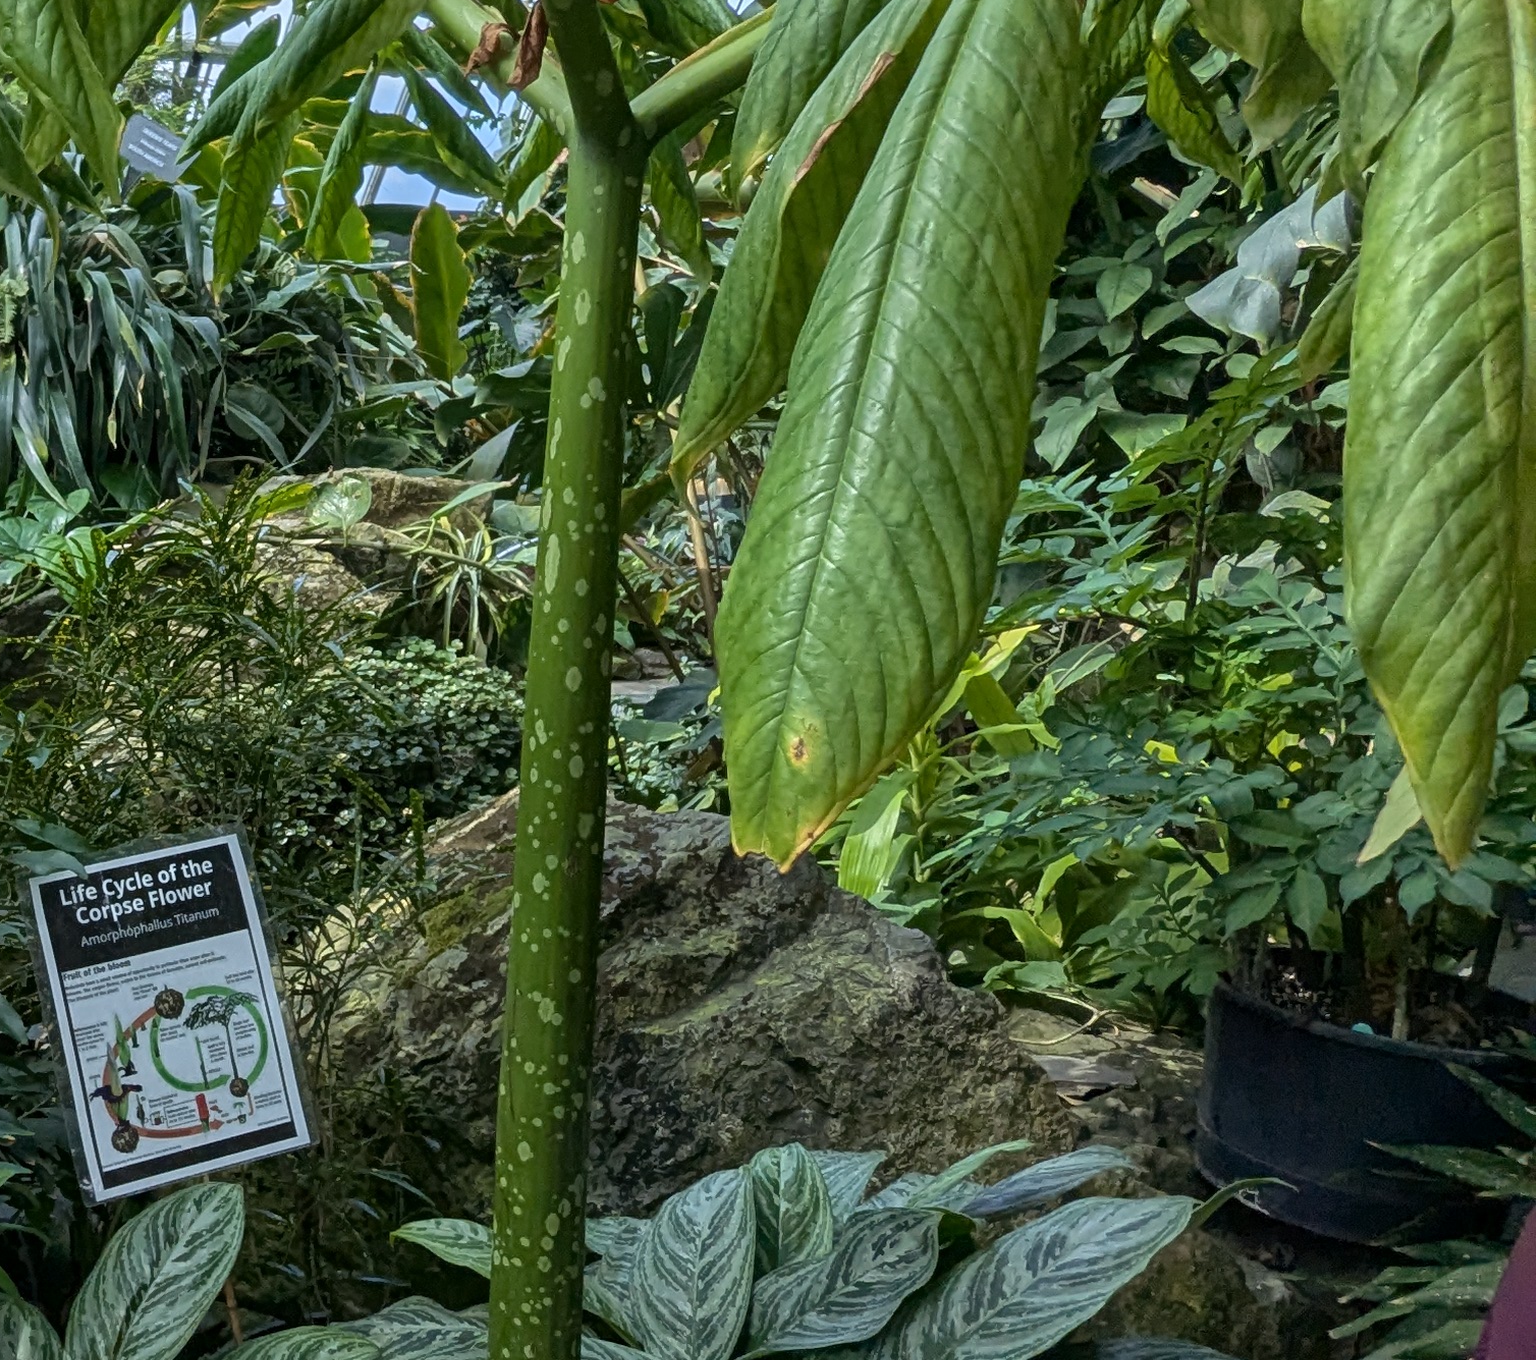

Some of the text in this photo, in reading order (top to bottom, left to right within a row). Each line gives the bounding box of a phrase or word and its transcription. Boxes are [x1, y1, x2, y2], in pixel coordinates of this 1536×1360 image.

[59, 859, 213, 906] Life Cycle of the
[76, 881, 212, 924] Corpse Flower
[81, 908, 219, 947] Amorphophallus Titanum
